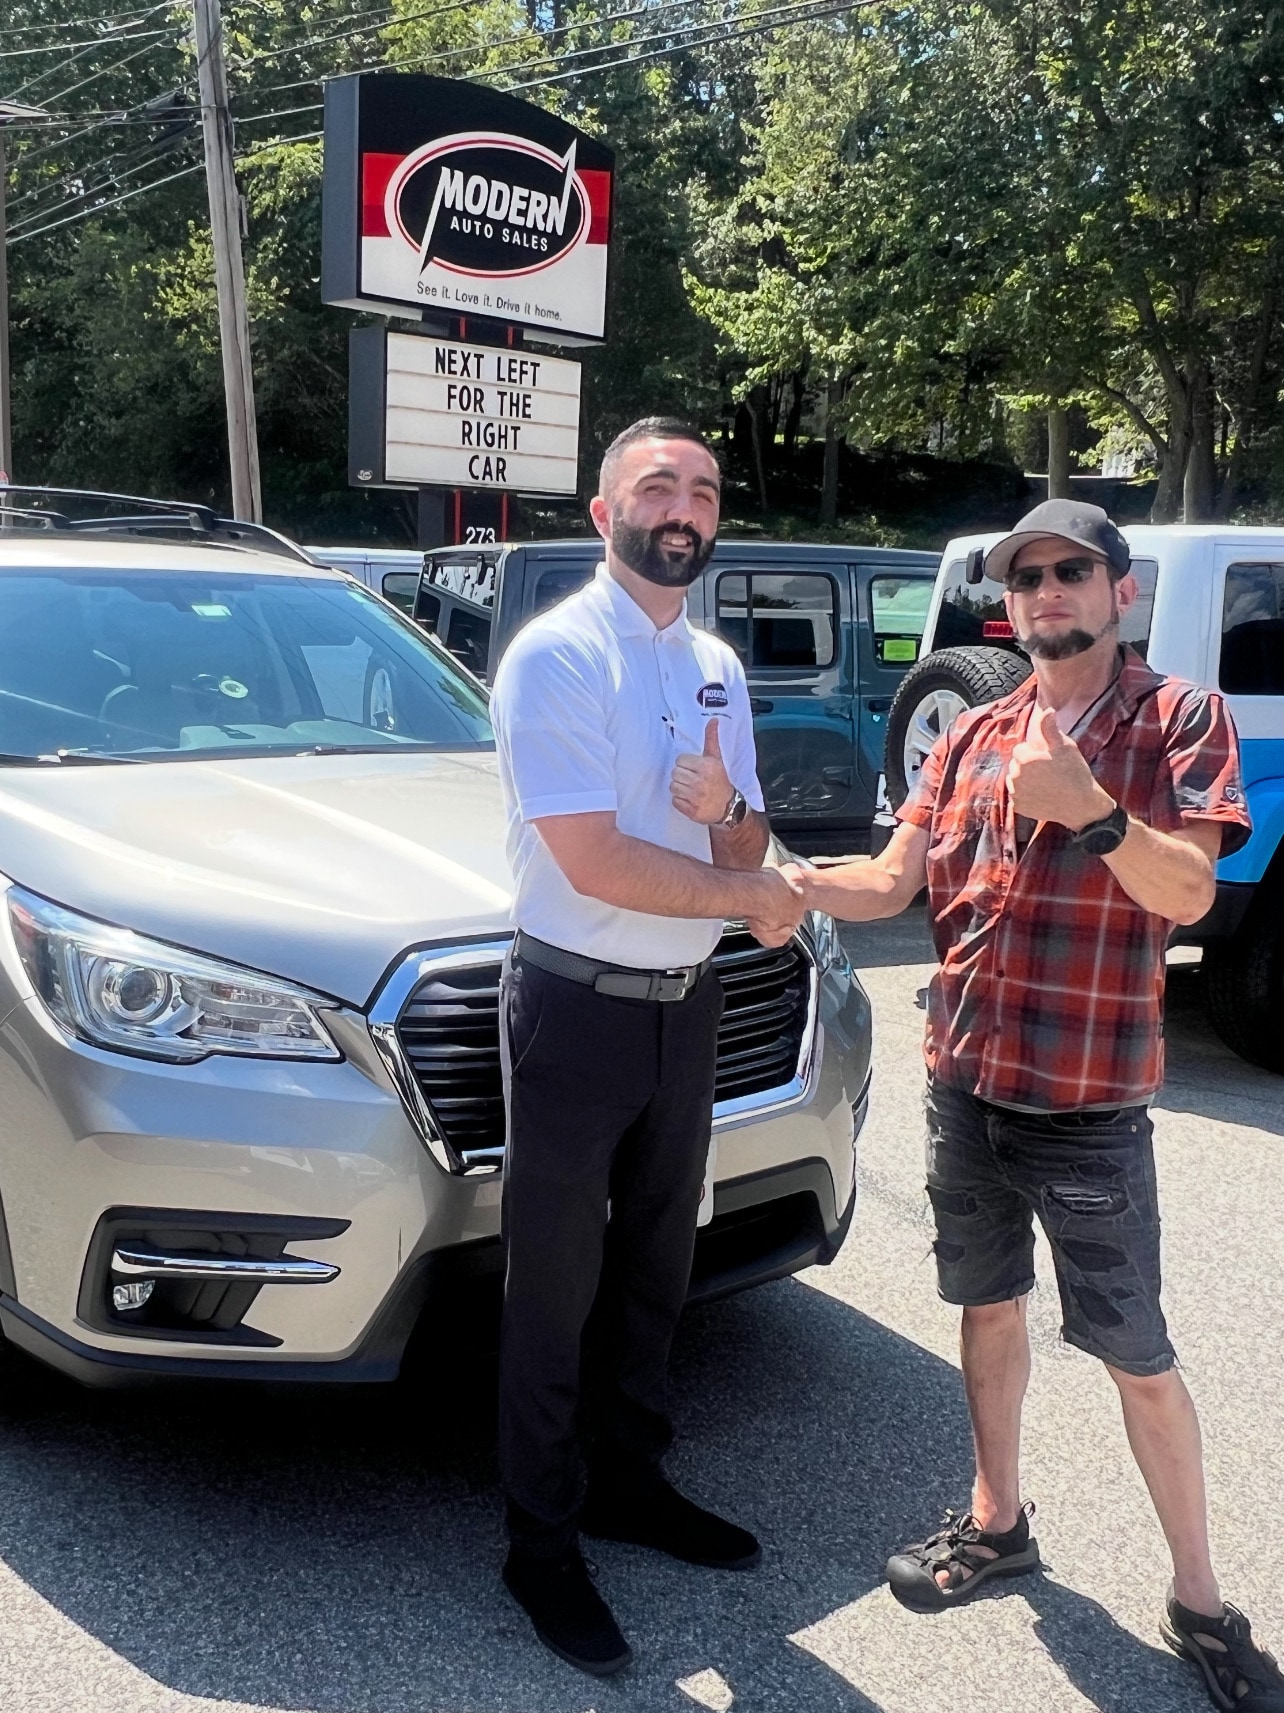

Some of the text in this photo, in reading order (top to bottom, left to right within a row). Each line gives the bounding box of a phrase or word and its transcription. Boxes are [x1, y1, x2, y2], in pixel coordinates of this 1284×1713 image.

[450, 216, 548, 252] AUTO SALES
[417, 281, 437, 297] See
[442, 285, 451, 299] it.
[455, 288, 479, 305] Love
[483, 293, 493, 308] it.
[497, 297, 520, 313] Drive
[535, 304, 562, 322] home.
[435, 347, 540, 387] NEXT LEFT
[447, 384, 532, 419] FOR THE
[462, 420, 521, 451] RIGHT
[468, 454, 507, 483] CAR
[465, 526, 496, 544] 273
